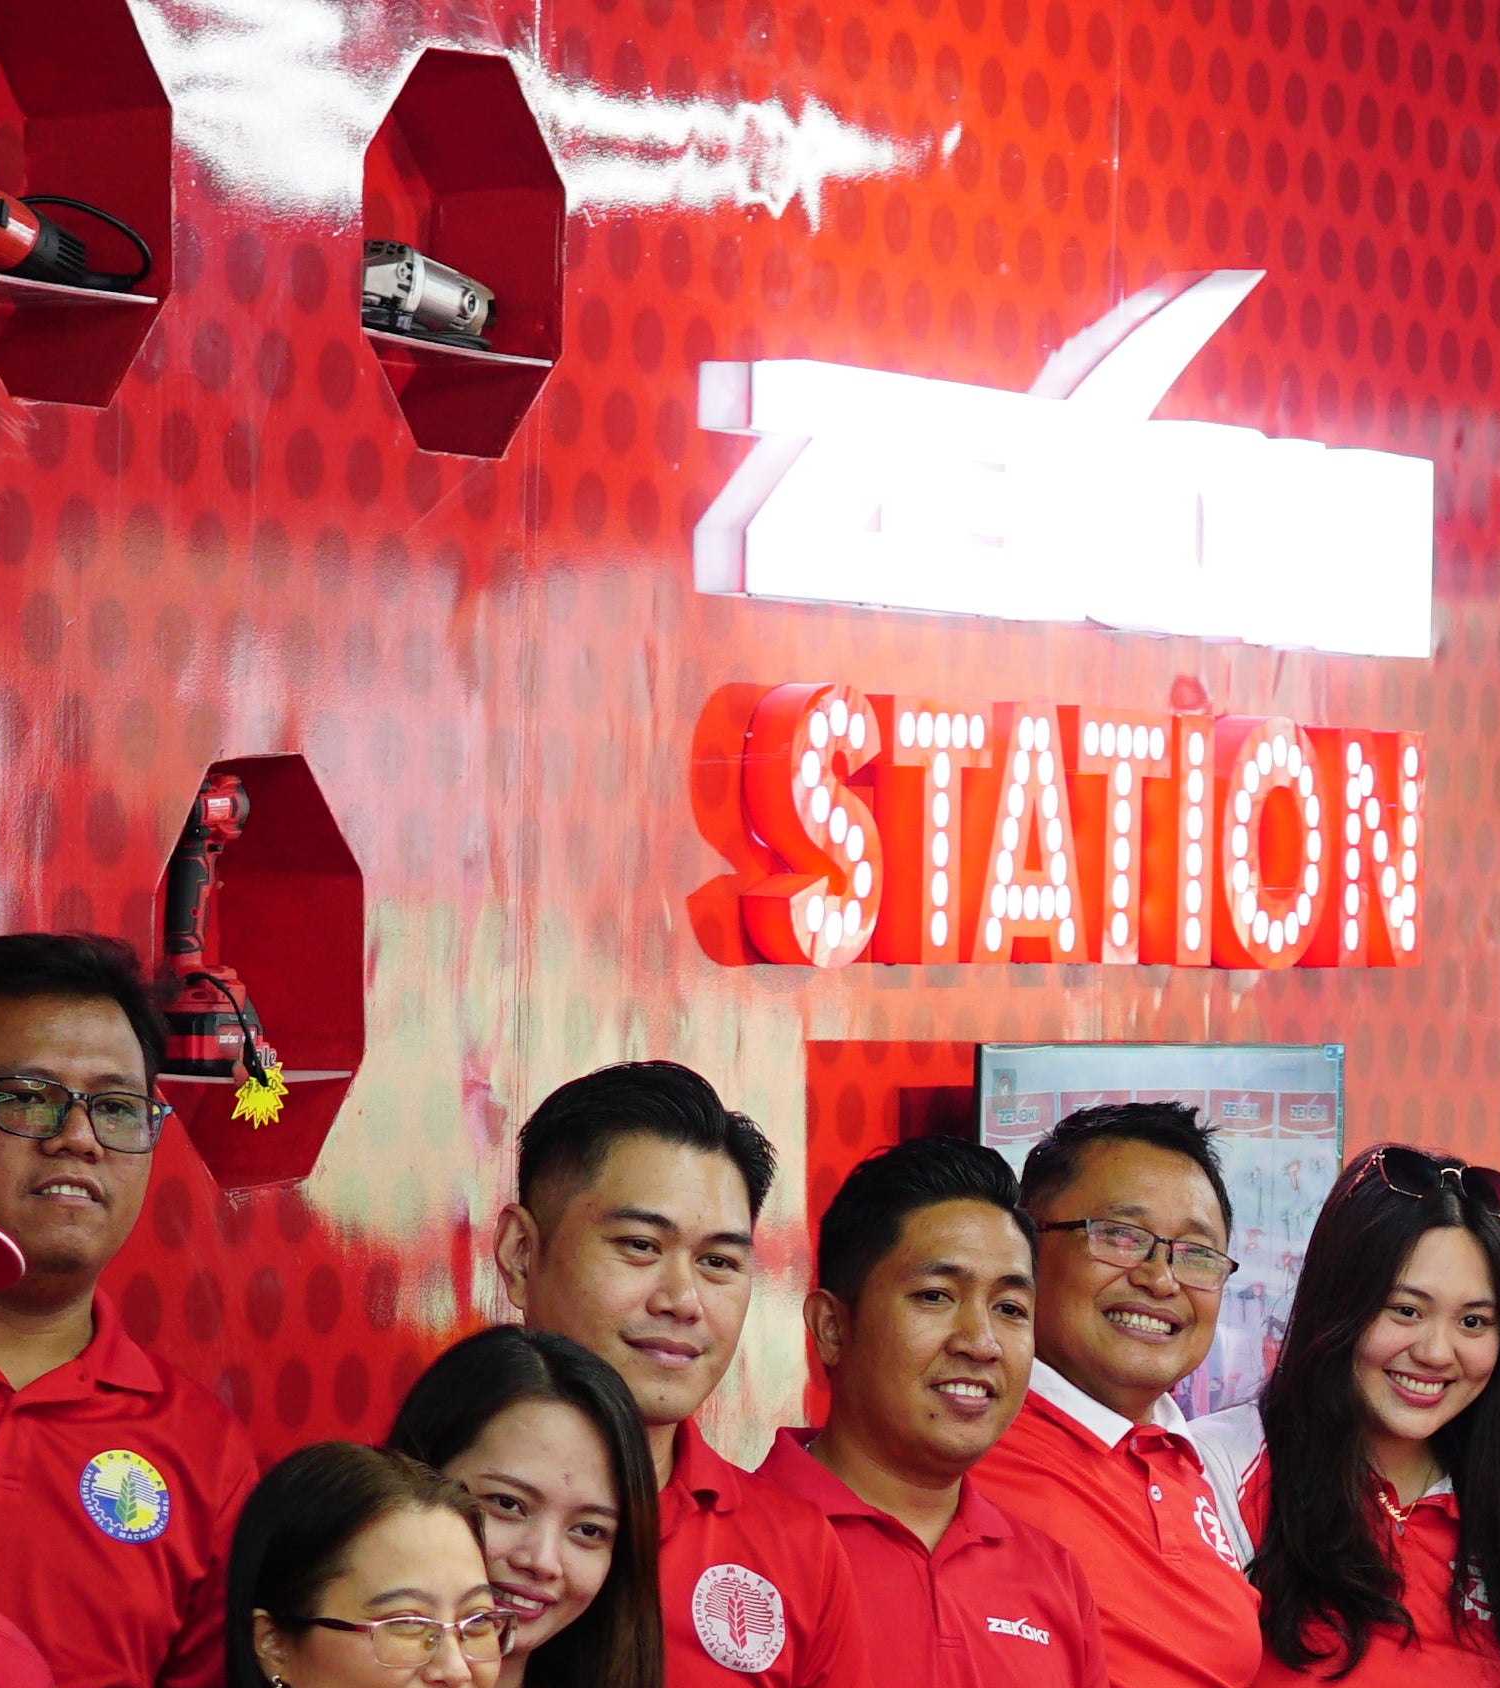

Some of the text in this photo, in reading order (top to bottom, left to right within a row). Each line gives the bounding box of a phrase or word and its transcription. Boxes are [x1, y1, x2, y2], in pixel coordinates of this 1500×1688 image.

[694, 269, 1434, 659] ZEKO
[740, 682, 1428, 970] STATION
[986, 1616, 1050, 1646] ZEKOKI
